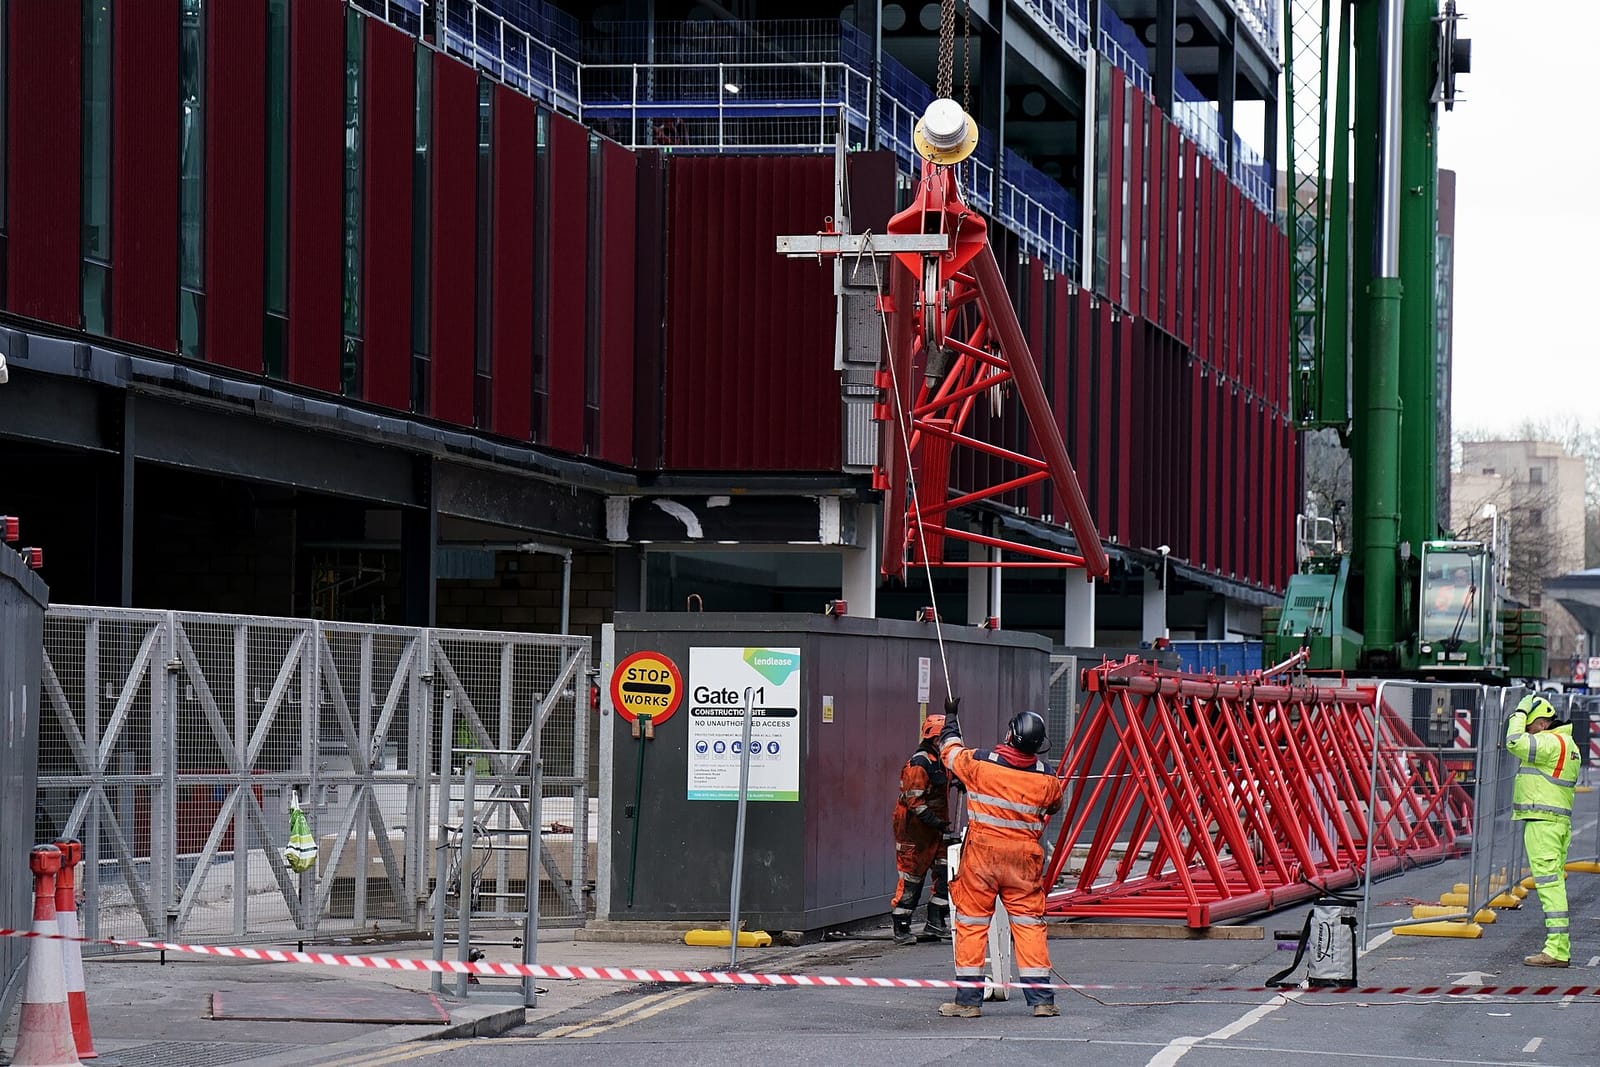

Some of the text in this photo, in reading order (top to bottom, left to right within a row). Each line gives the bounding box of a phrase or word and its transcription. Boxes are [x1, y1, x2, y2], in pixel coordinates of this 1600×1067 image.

[754, 657, 792, 666] lendlease
[627, 668, 670, 682] STOP
[624, 695, 669, 706] WORKS
[694, 686, 739, 705] Gate
